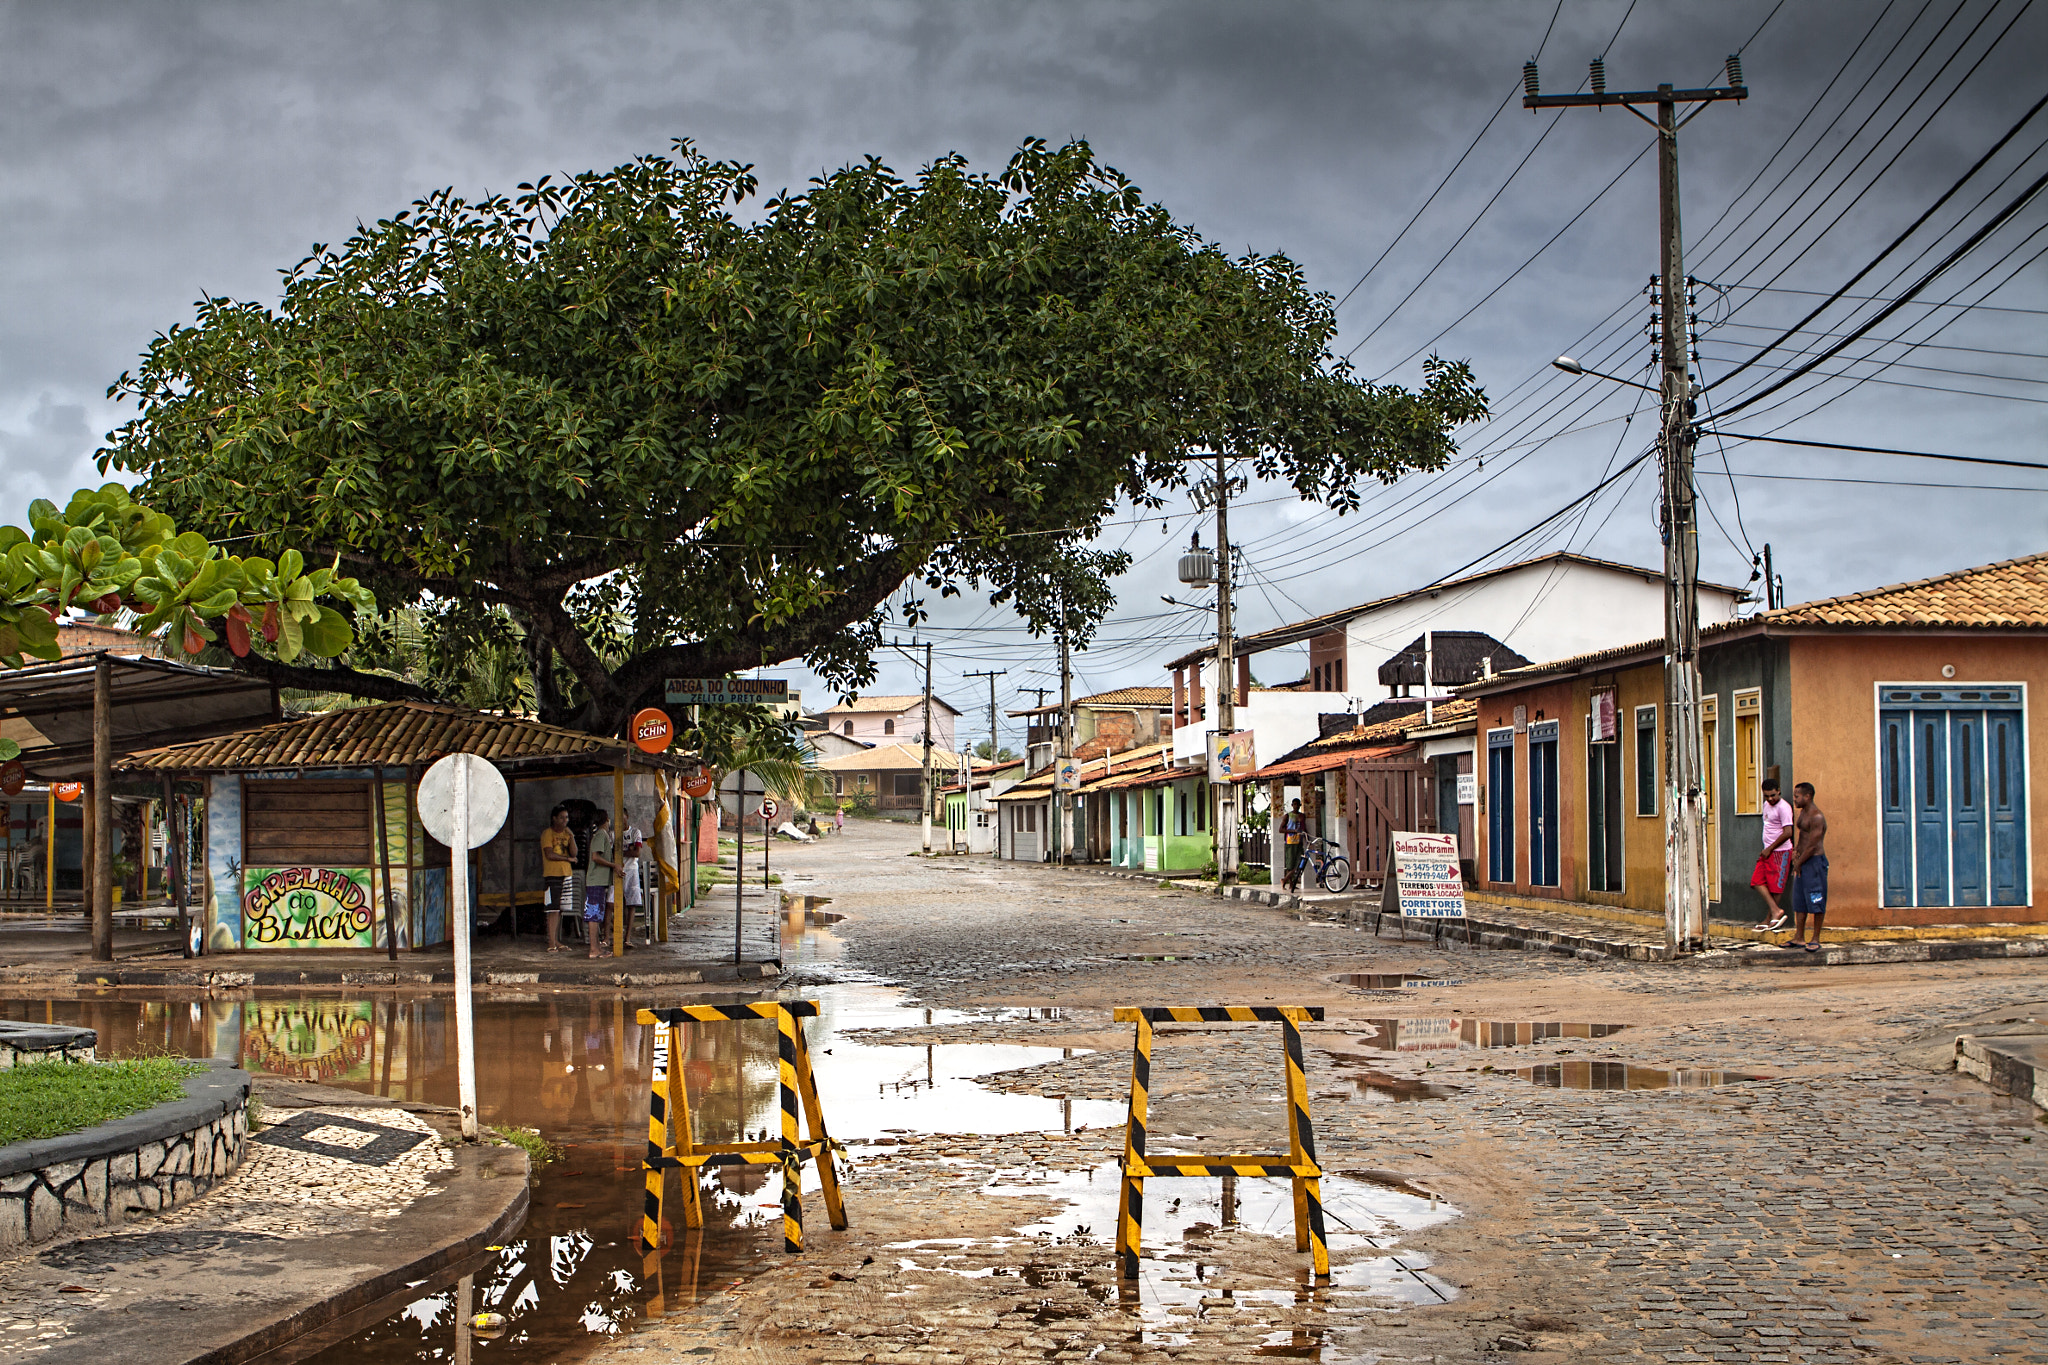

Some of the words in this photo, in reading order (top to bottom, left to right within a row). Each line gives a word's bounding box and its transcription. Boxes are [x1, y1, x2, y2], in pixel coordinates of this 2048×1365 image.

[666, 680, 704, 694] ADEGA
[707, 680, 724, 694] DO
[727, 680, 786, 695] COQUINHO
[690, 693, 724, 703] ZELITO
[731, 694, 763, 703] PRETO
[638, 724, 667, 739] SCHIN
[58, 782, 78, 793] SCHIN
[687, 776, 708, 789] SCHIN
[763, 802, 773, 815] E
[1395, 840, 1418, 853] Selma
[1418, 842, 1455, 854] Schramm
[244, 868, 372, 932] GRELHADO
[1401, 899, 1463, 909] CORRETORES
[1406, 908, 1417, 917] DE
[247, 911, 357, 943] BLACK
[652, 1020, 671, 1082] PMER
